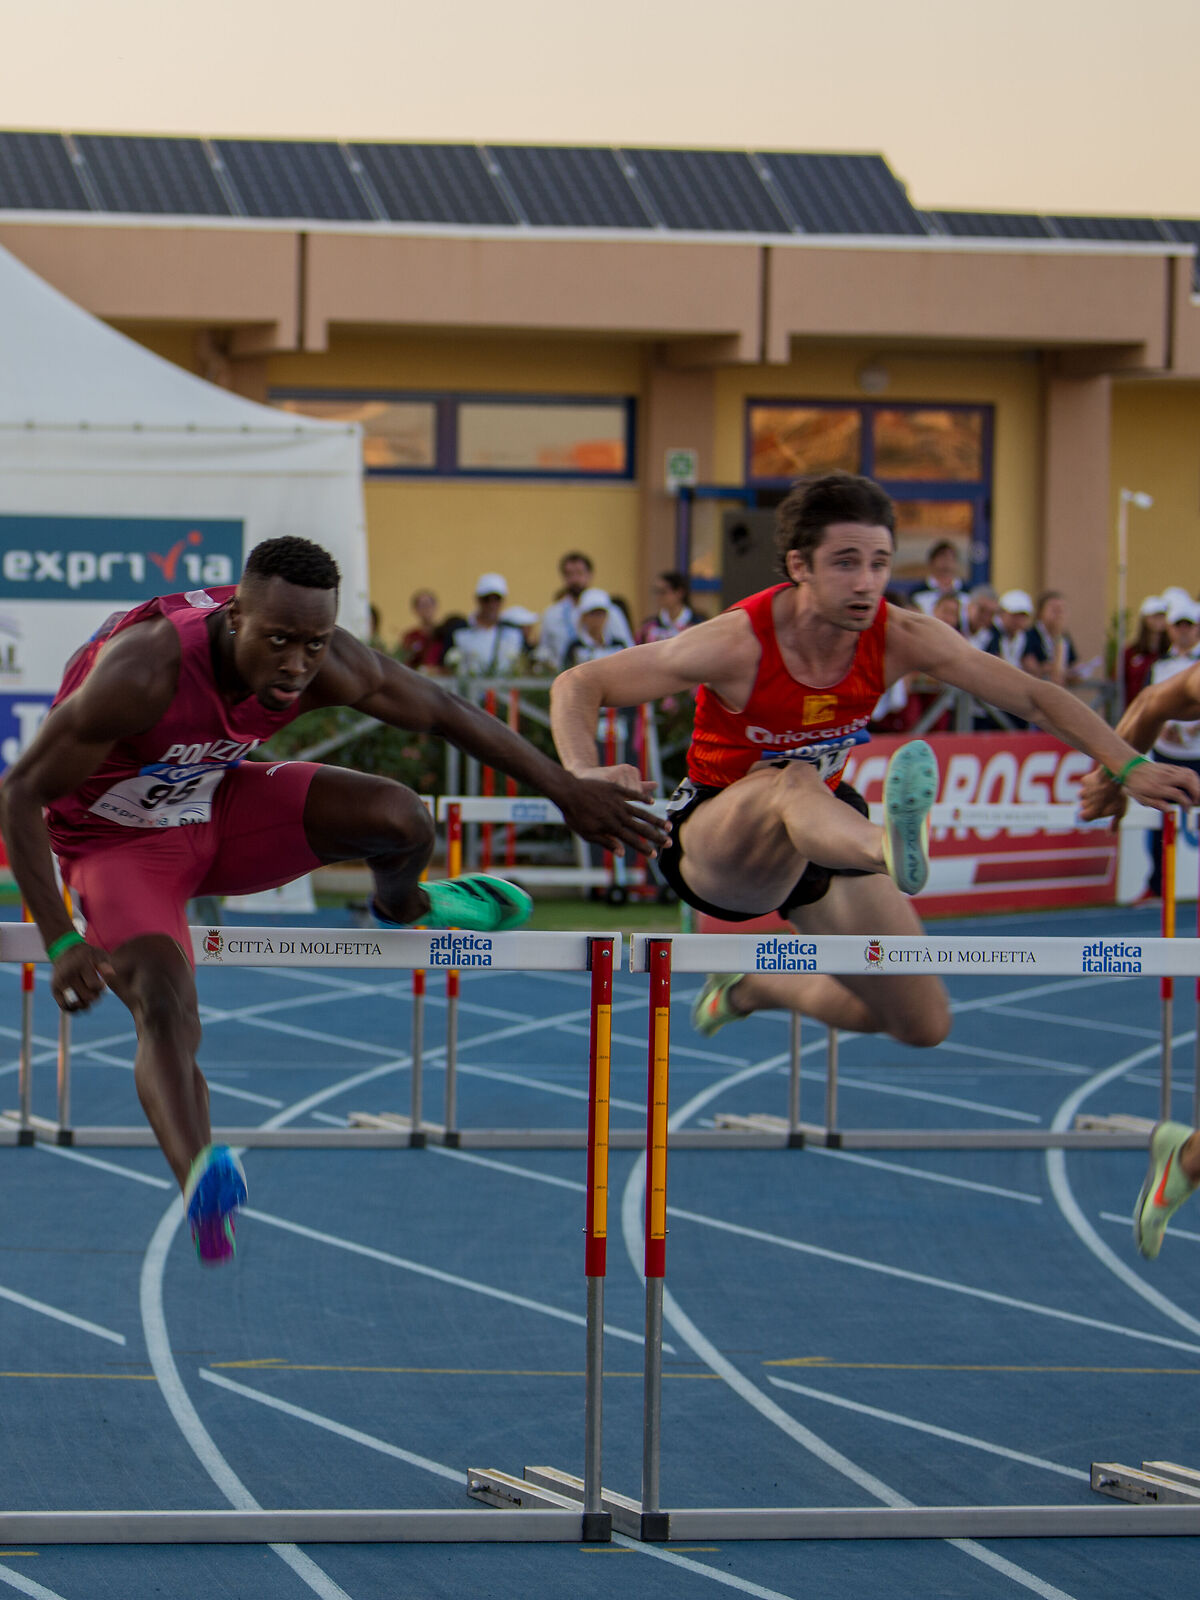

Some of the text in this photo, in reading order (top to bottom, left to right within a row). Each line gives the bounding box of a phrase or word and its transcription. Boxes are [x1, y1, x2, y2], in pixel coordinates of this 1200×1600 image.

[2, 530, 233, 590] exprivia
[138, 775, 203, 810] 95
[228, 938, 382, 955] CITTÀ DI MOLFETTA
[430, 933, 492, 950] atletica
[756, 938, 817, 955] atletica
[1082, 941, 1142, 957] atletica
[430, 949, 492, 966] italiana
[756, 953, 817, 970] italiana
[888, 947, 1037, 963] CITTÀ DI MOLFETTA
[1082, 956, 1142, 973] italiana
